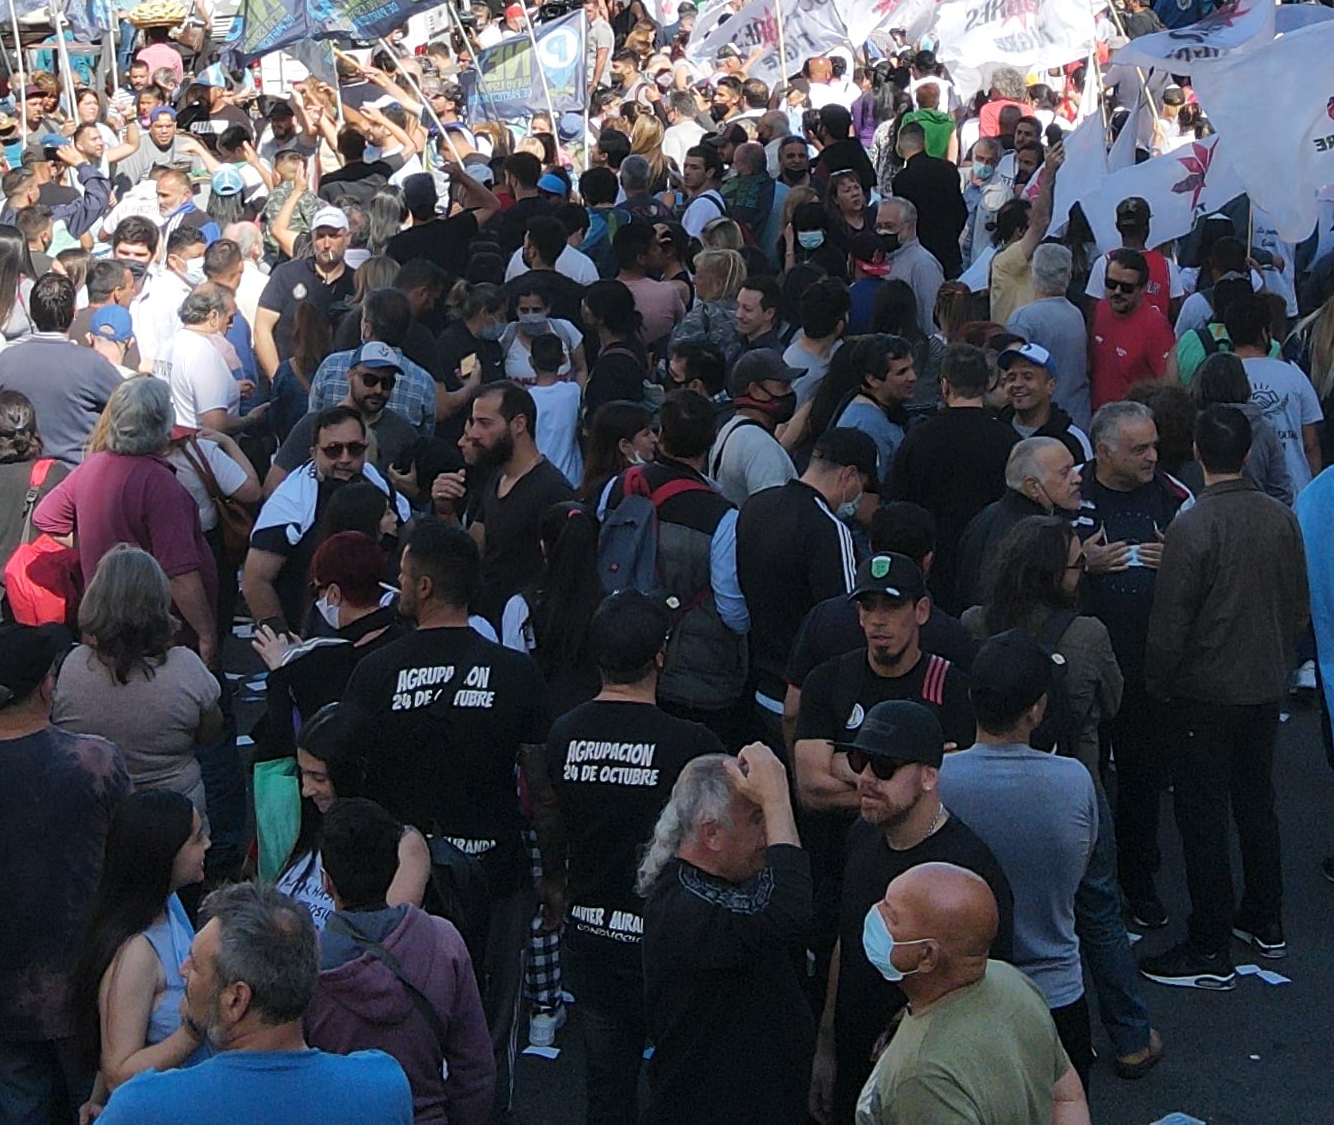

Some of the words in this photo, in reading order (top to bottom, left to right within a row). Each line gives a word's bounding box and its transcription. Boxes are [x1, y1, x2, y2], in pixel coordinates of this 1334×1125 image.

[396, 665, 491, 693] AGRUPON
[392, 691, 412, 710] 24
[415, 690, 433, 707] DE
[567, 739, 657, 767] AGRUPACION
[563, 764, 580, 781] 24
[581, 766, 597, 783] DE
[599, 766, 660, 787] OCTUBRE
